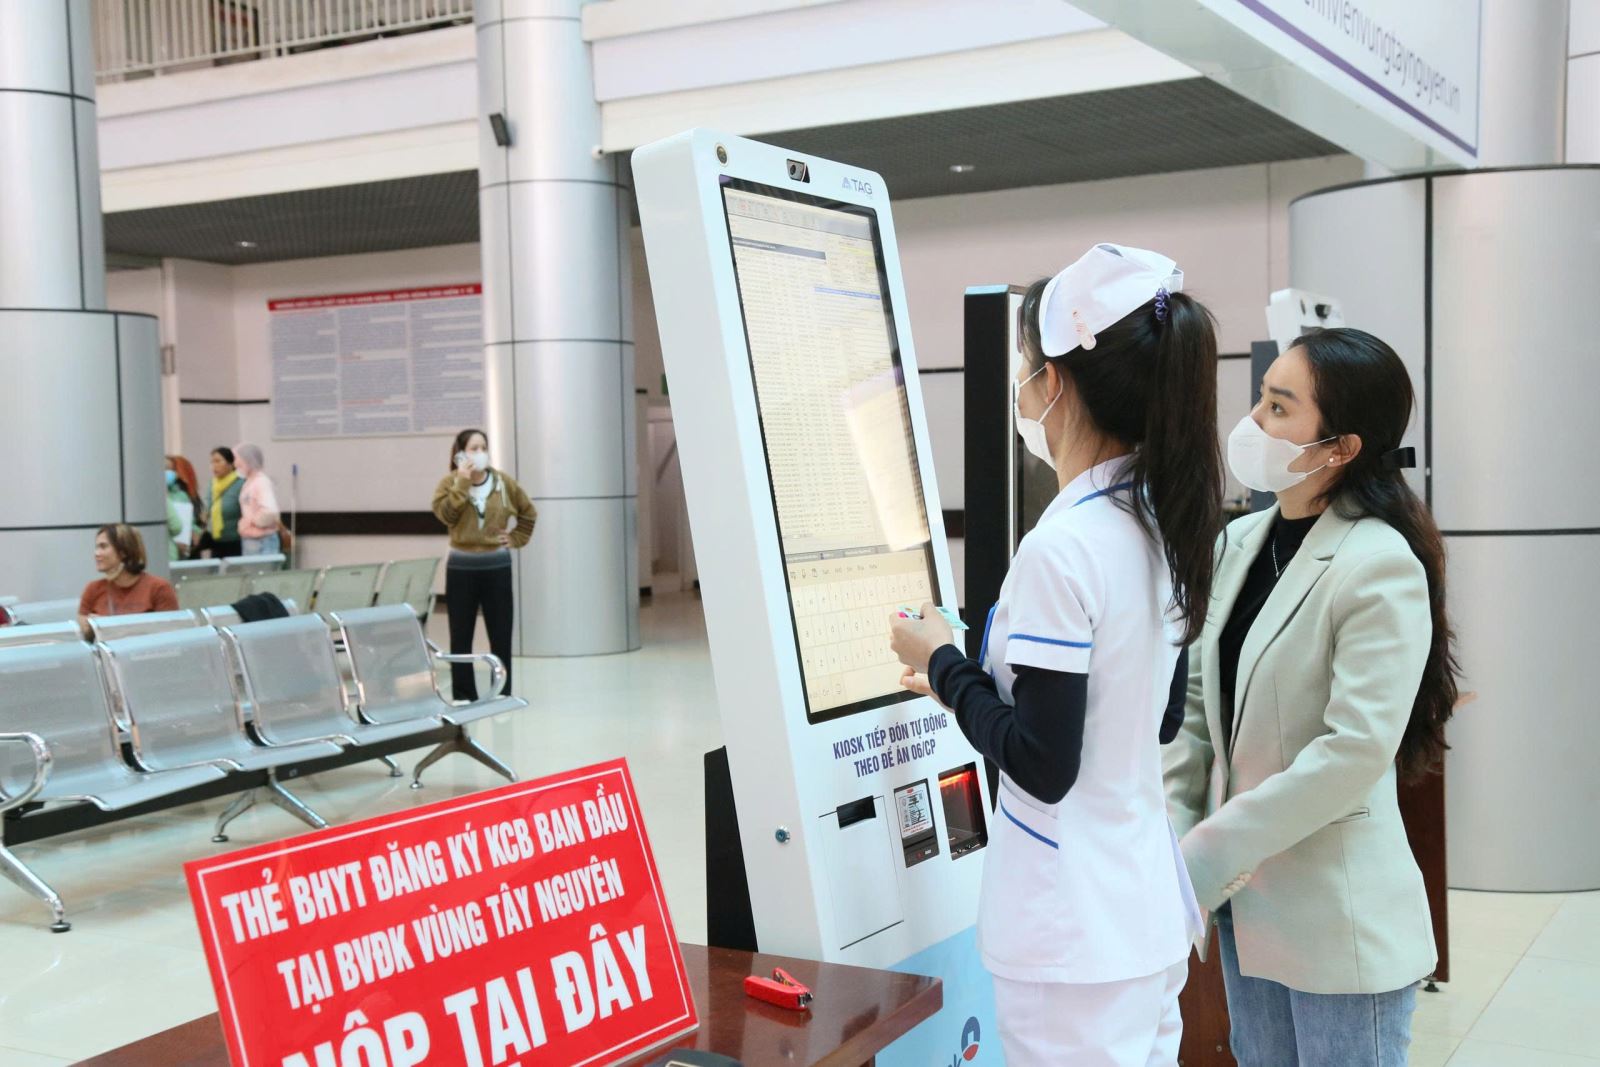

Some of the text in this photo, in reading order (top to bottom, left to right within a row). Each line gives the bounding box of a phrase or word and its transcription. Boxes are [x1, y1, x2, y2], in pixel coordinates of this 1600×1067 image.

[850, 178, 873, 195] TAG
[833, 713, 948, 759] KIOSK TIẾP ĐÓN TỰ ĐỘNG
[854, 756, 880, 777] THEO
[896, 745, 911, 765] ÁN
[911, 739, 936, 760] 06/CP
[221, 783, 629, 944] THẺ BHYT ĐĂNG KÝ KCB BAN ĐẦU
[276, 855, 625, 1015] TẠI BVĐK VÙNG TÂY NGUYÊN
[443, 966, 548, 1067] TẠI
[550, 923, 654, 1034] ĐÂY
